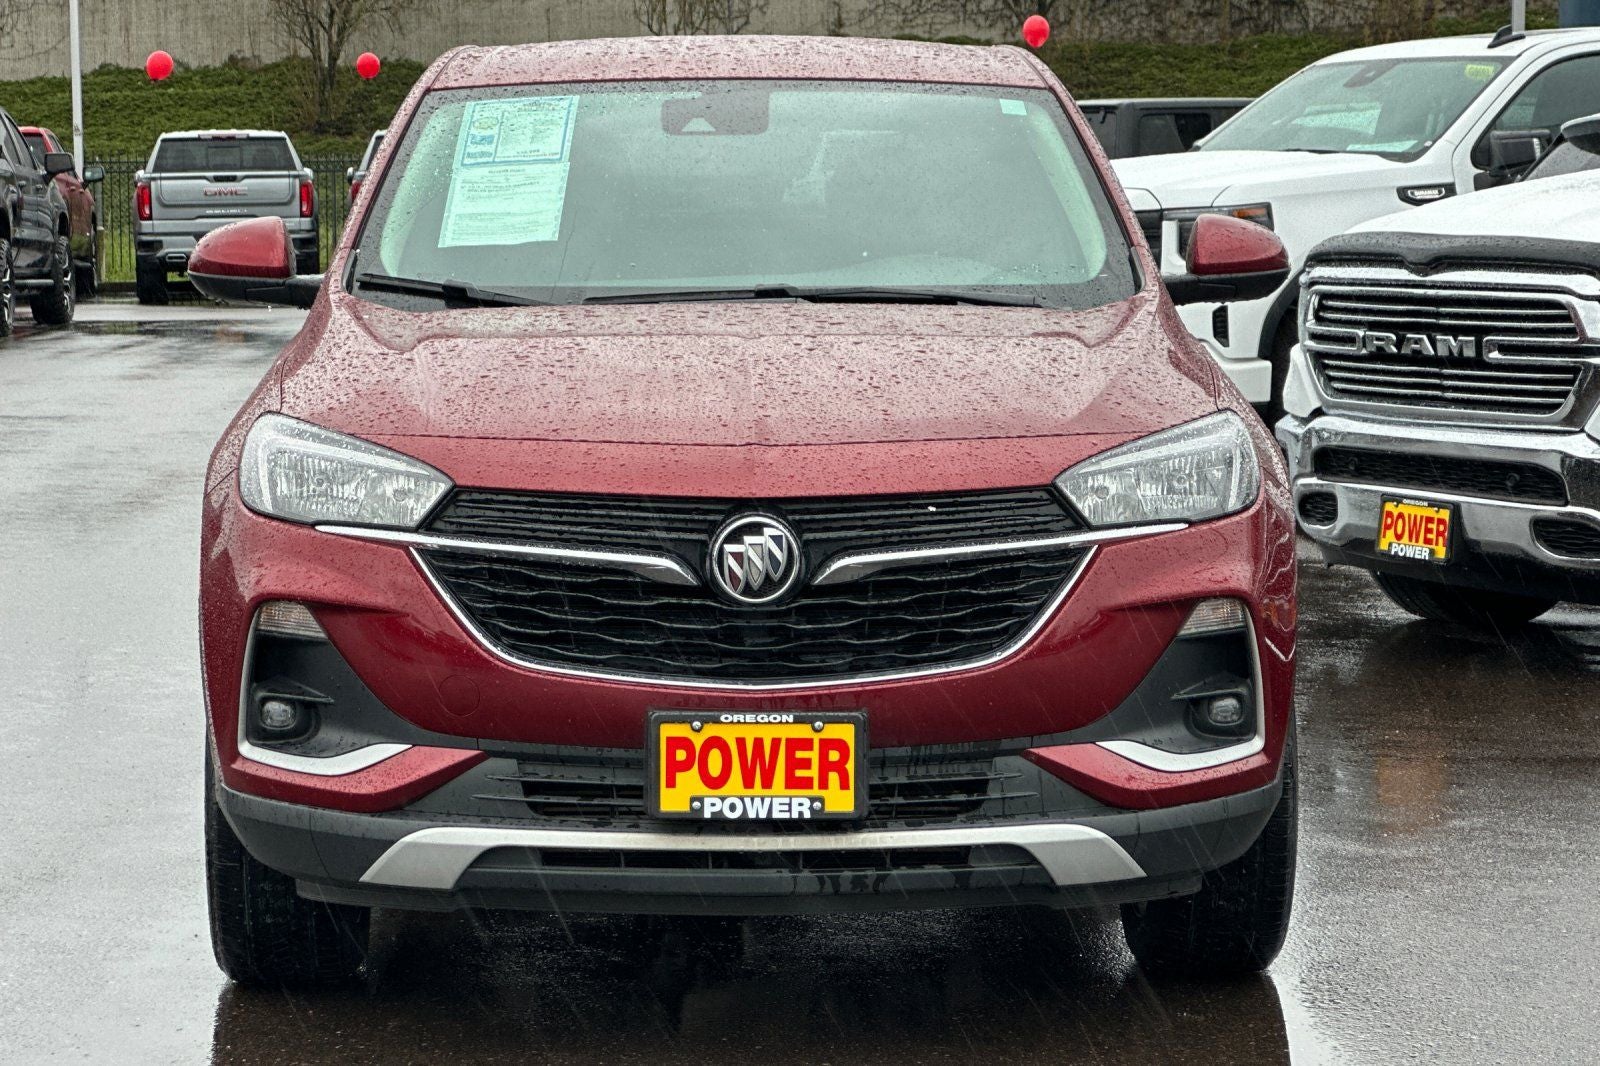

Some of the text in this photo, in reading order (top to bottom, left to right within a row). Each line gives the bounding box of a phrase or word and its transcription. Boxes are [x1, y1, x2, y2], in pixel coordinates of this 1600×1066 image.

[203, 186, 248, 196] GMC
[1365, 331, 1476, 358] RAM
[1382, 510, 1448, 548] POWER
[1391, 543, 1430, 560] POWER
[720, 714, 794, 723] OREGON
[665, 735, 851, 791] POWER
[703, 796, 812, 819] POWER
